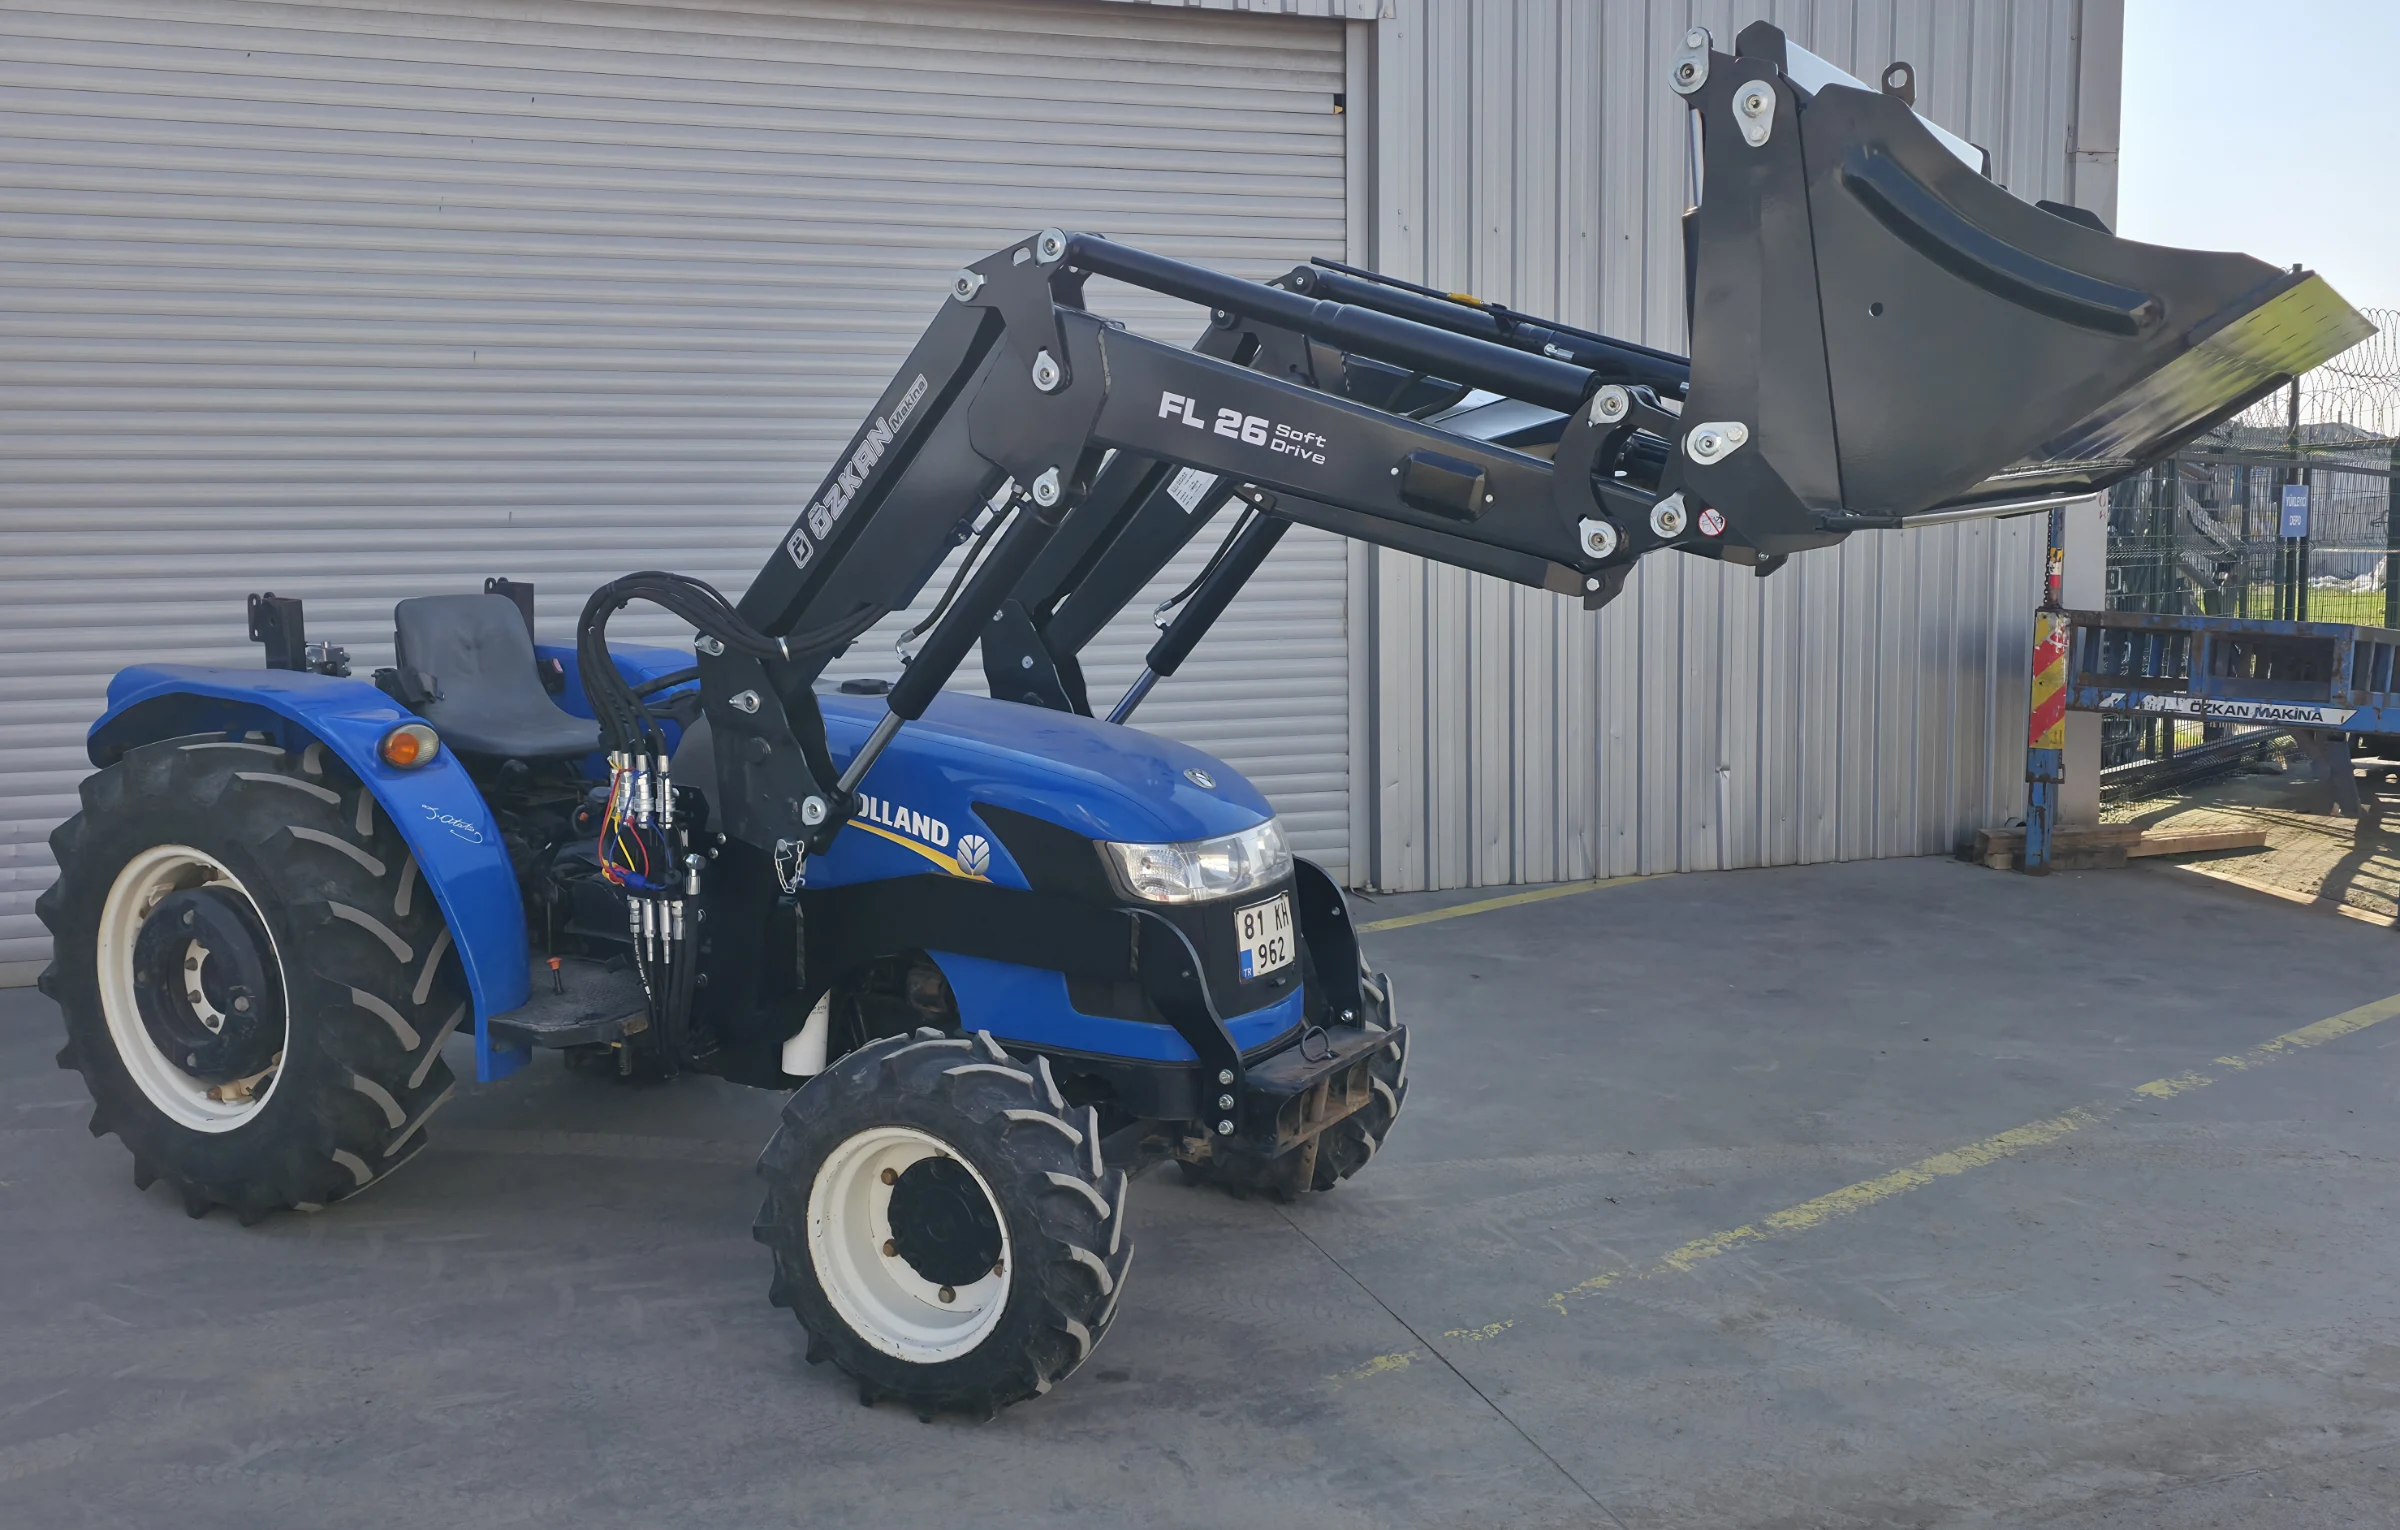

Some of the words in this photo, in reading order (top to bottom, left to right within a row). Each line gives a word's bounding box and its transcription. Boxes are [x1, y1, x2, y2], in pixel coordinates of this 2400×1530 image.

[1158, 390, 1205, 429] FL
[1213, 407, 1270, 447] 26
[1275, 423, 1327, 448] Soft
[808, 416, 893, 540] ÖZKAN
[890, 379, 927, 430] Makina
[1270, 438, 1326, 465] Drive
[2190, 700, 2250, 716] ÖZKAN
[2254, 706, 2324, 722] MAKİNA
[1244, 910, 1264, 940] 81
[1274, 901, 1290, 931] KH
[1258, 936, 1286, 969] 962
[1243, 967, 1252, 978] TR
